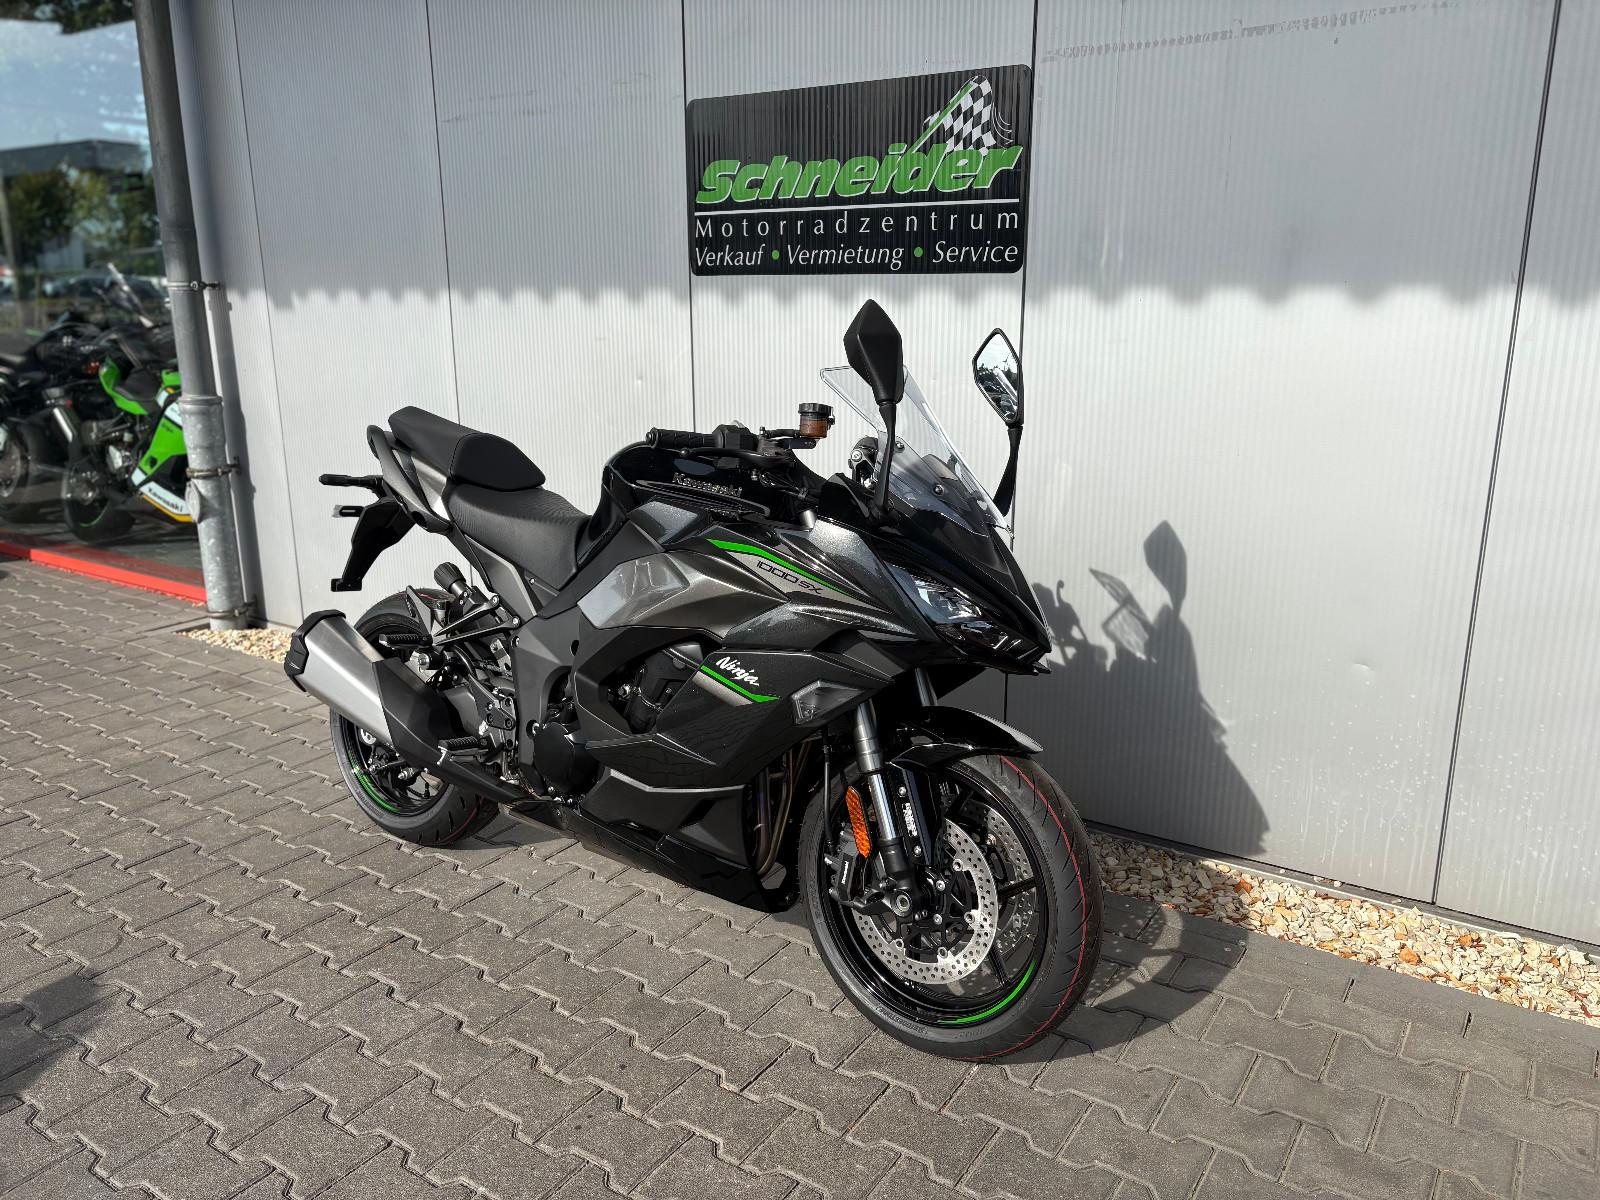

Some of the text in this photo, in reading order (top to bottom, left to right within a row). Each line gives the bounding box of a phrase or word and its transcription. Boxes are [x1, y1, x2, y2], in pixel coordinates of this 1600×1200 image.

[695, 211, 1019, 238] Motorradzentrum
[695, 240, 1019, 270] Verkauf Vermietung Service
[757, 560, 823, 594] 1000 SX
[715, 656, 760, 686] Ninja
